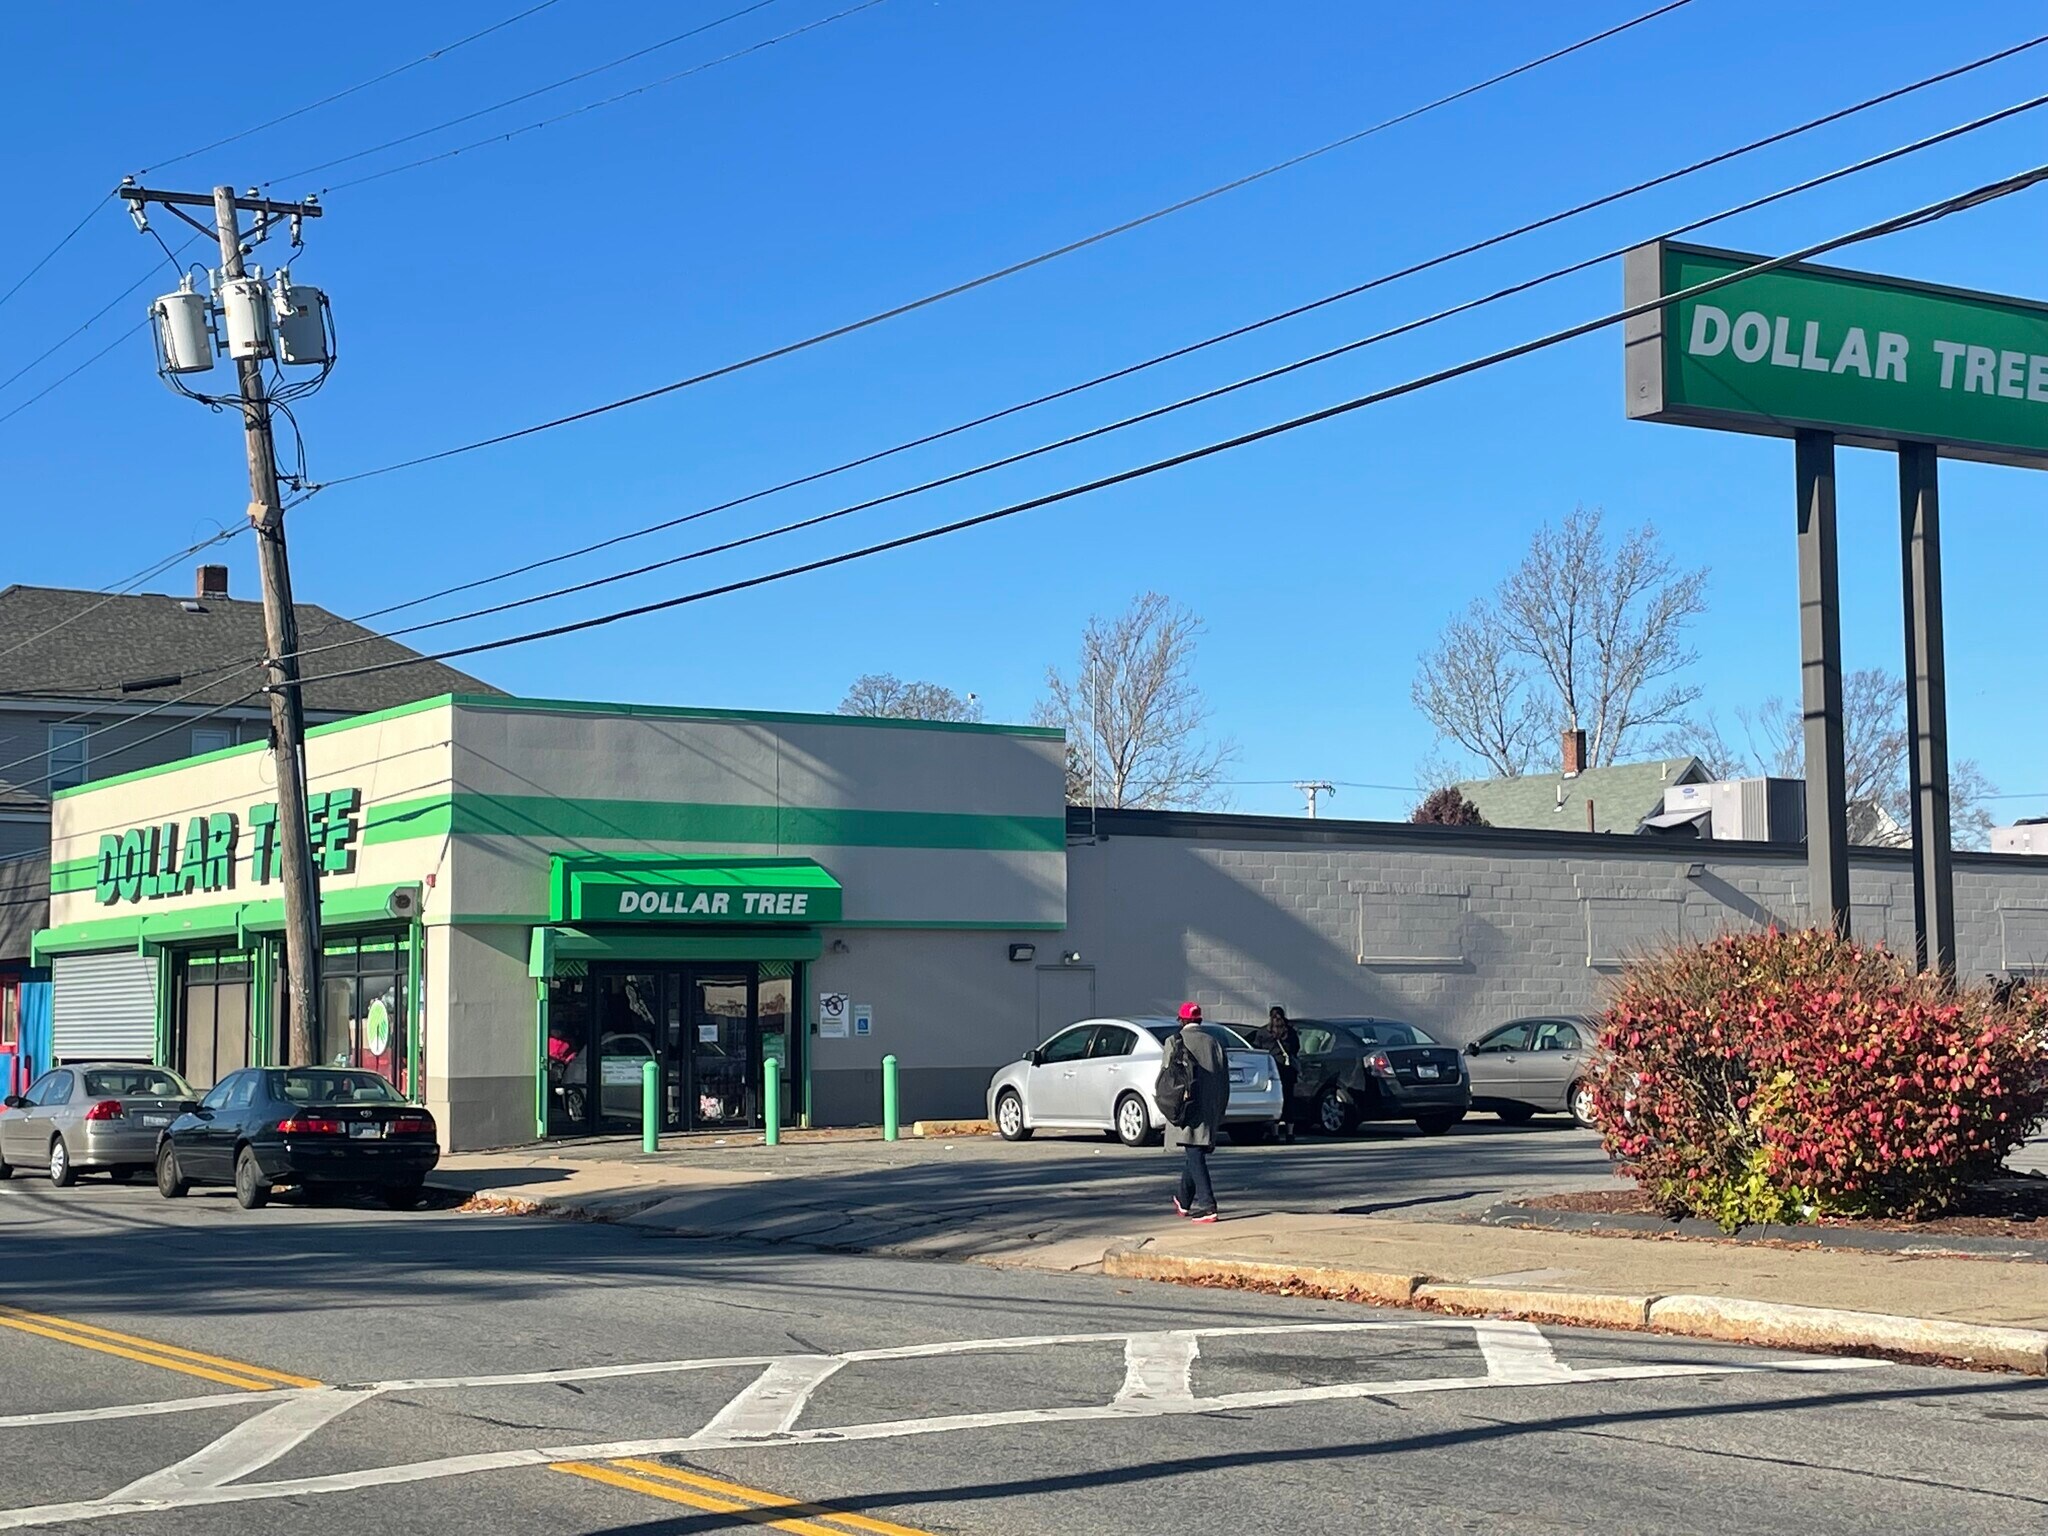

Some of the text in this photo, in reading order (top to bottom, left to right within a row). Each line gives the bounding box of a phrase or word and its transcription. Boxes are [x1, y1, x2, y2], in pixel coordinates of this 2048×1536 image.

[1688, 304, 2048, 403] DOLLAR TREE
[95, 811, 238, 905] DOLLAR
[618, 891, 809, 915] DOLLAR TREE
